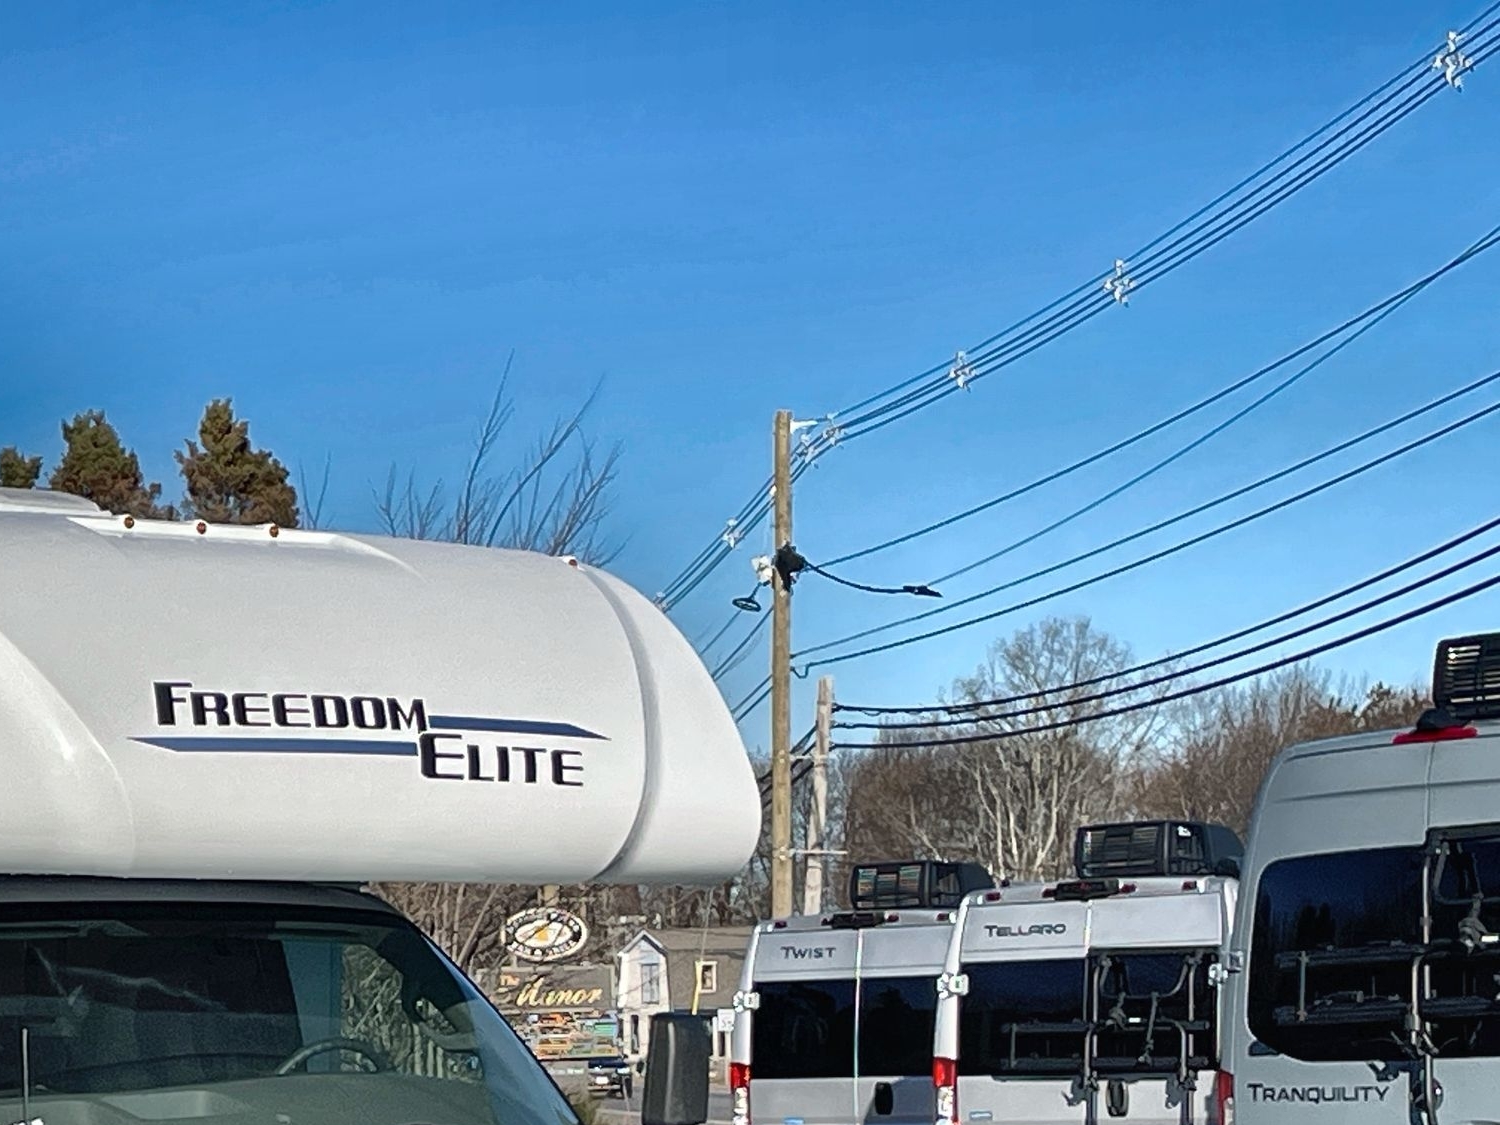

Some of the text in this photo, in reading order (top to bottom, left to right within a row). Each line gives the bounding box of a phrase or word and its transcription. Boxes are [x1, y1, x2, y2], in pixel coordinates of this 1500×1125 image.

[153, 681, 428, 733] FREEDOM
[418, 732, 584, 787] ELITE
[984, 923, 1067, 938] TELLARO
[780, 945, 837, 960] TWIST
[1246, 1082, 1390, 1105] TRANQUILITY
